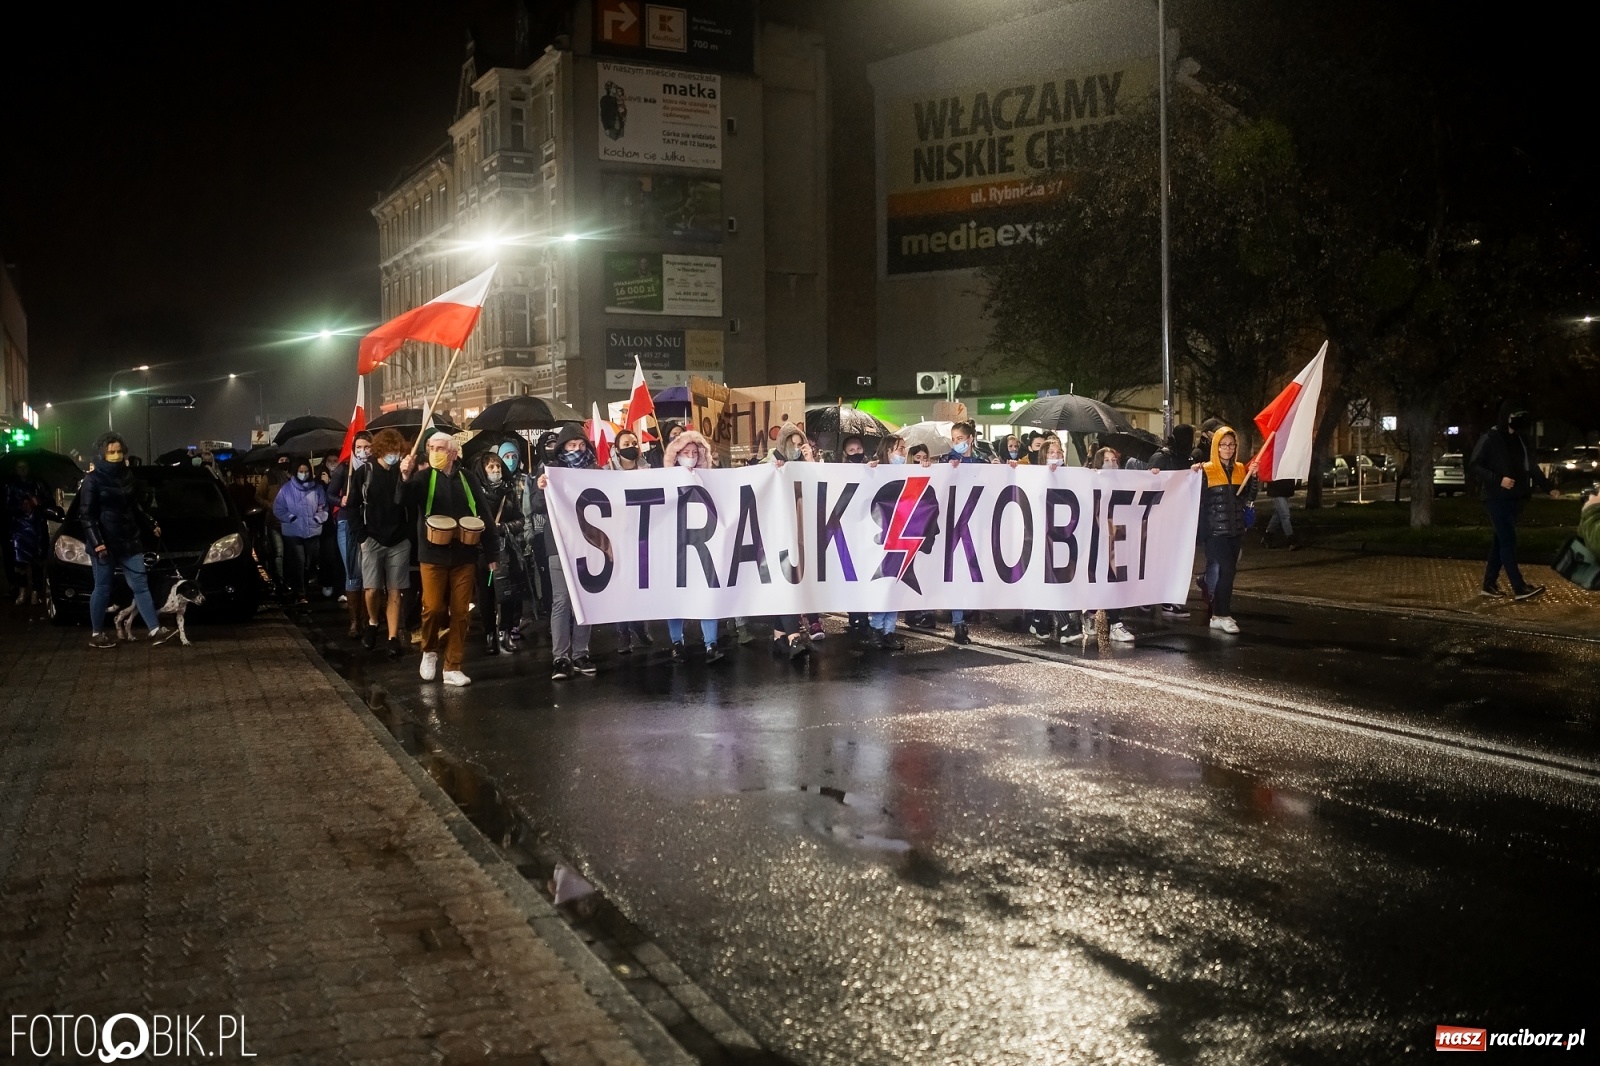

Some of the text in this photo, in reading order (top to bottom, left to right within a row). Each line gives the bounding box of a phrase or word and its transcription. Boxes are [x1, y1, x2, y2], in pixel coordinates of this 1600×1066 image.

[652, 34, 682, 44] Kaufland
[692, 39, 719, 51] 700 m
[603, 63, 611, 71] W
[613, 64, 644, 76] naszym
[646, 68, 676, 79] mieście
[663, 83, 717, 100] matka
[914, 71, 1124, 139] WŁĄCZAMY
[662, 129, 680, 138] Córka
[681, 131, 691, 139] nie
[662, 138, 679, 146] TATY
[697, 141, 718, 150] lutego.
[603, 146, 640, 159] Kocham
[913, 135, 1015, 184] NISKIE
[970, 189, 986, 204] ul.
[615, 284, 655, 296] 16 000 zł
[575, 480, 1165, 594] STRAJK KOBIET
